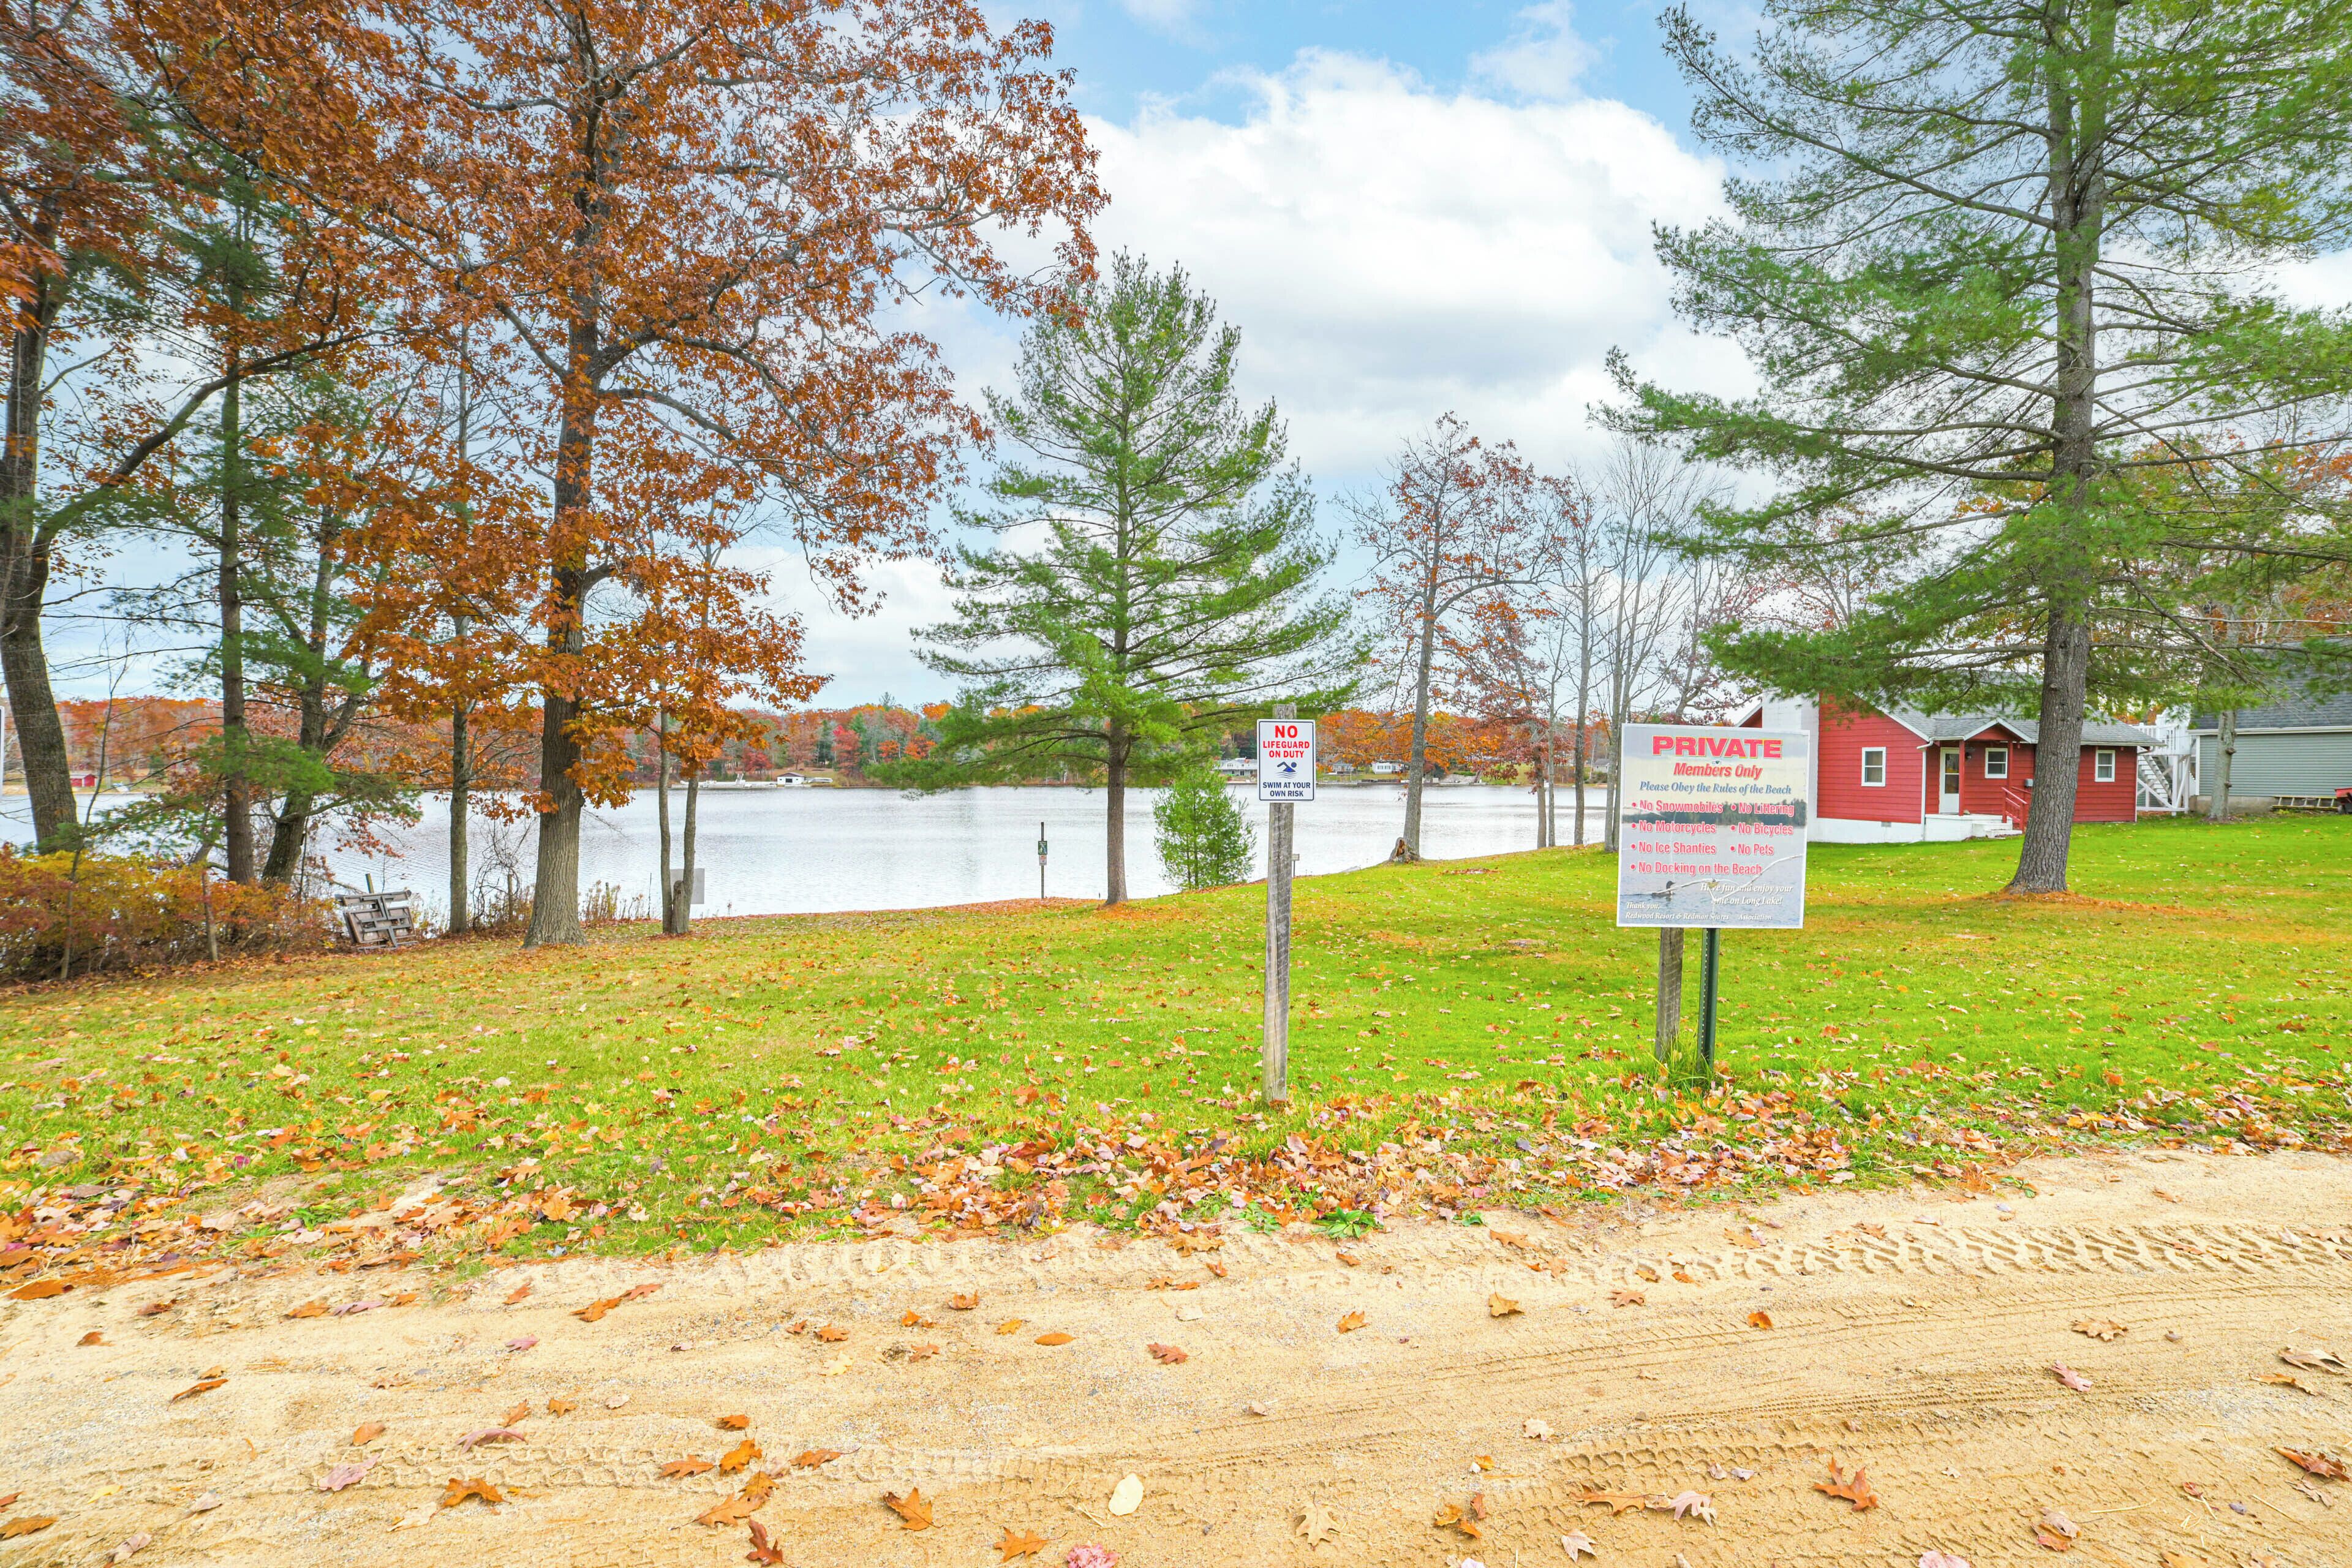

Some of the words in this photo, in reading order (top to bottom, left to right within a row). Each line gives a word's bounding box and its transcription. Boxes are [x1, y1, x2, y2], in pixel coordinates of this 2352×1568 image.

[1275, 725, 1298, 738] NO
[1652, 736, 1783, 759] PRIVATE
[1673, 763, 1732, 777] Members
[1735, 764, 1763, 780] Only
[1640, 782, 1670, 792] Please
[1671, 782, 1695, 795] Obey
[1697, 783, 1711, 792] the
[1713, 784, 1737, 793] Rules
[1739, 783, 1750, 796] of
[1750, 785, 1763, 793] the
[1765, 785, 1792, 794] Beach
[1640, 800, 1653, 811] No
[1656, 801, 1723, 813] Snowmobiles
[1739, 803, 1752, 814] No
[1755, 803, 1795, 817] Littering
[1639, 821, 1653, 832] No
[1655, 821, 1716, 835] Motorcycles
[1738, 823, 1751, 834] No
[1754, 823, 1793, 837] Bicycles
[1638, 842, 1652, 853] No
[1655, 842, 1670, 853] Ice
[1673, 842, 1716, 854] Shanties
[1738, 843, 1751, 854] No
[1754, 843, 1774, 856] Pets
[1638, 862, 1652, 873] No
[1654, 862, 1695, 876] Docking
[1698, 865, 1711, 874] on
[1713, 863, 1730, 875] the
[1732, 863, 1762, 875] Beach
[1721, 884, 1736, 894] fun
[1754, 884, 1774, 895] enjoy
[1775, 885, 1793, 895] your
[1742, 897, 1761, 907] Long
